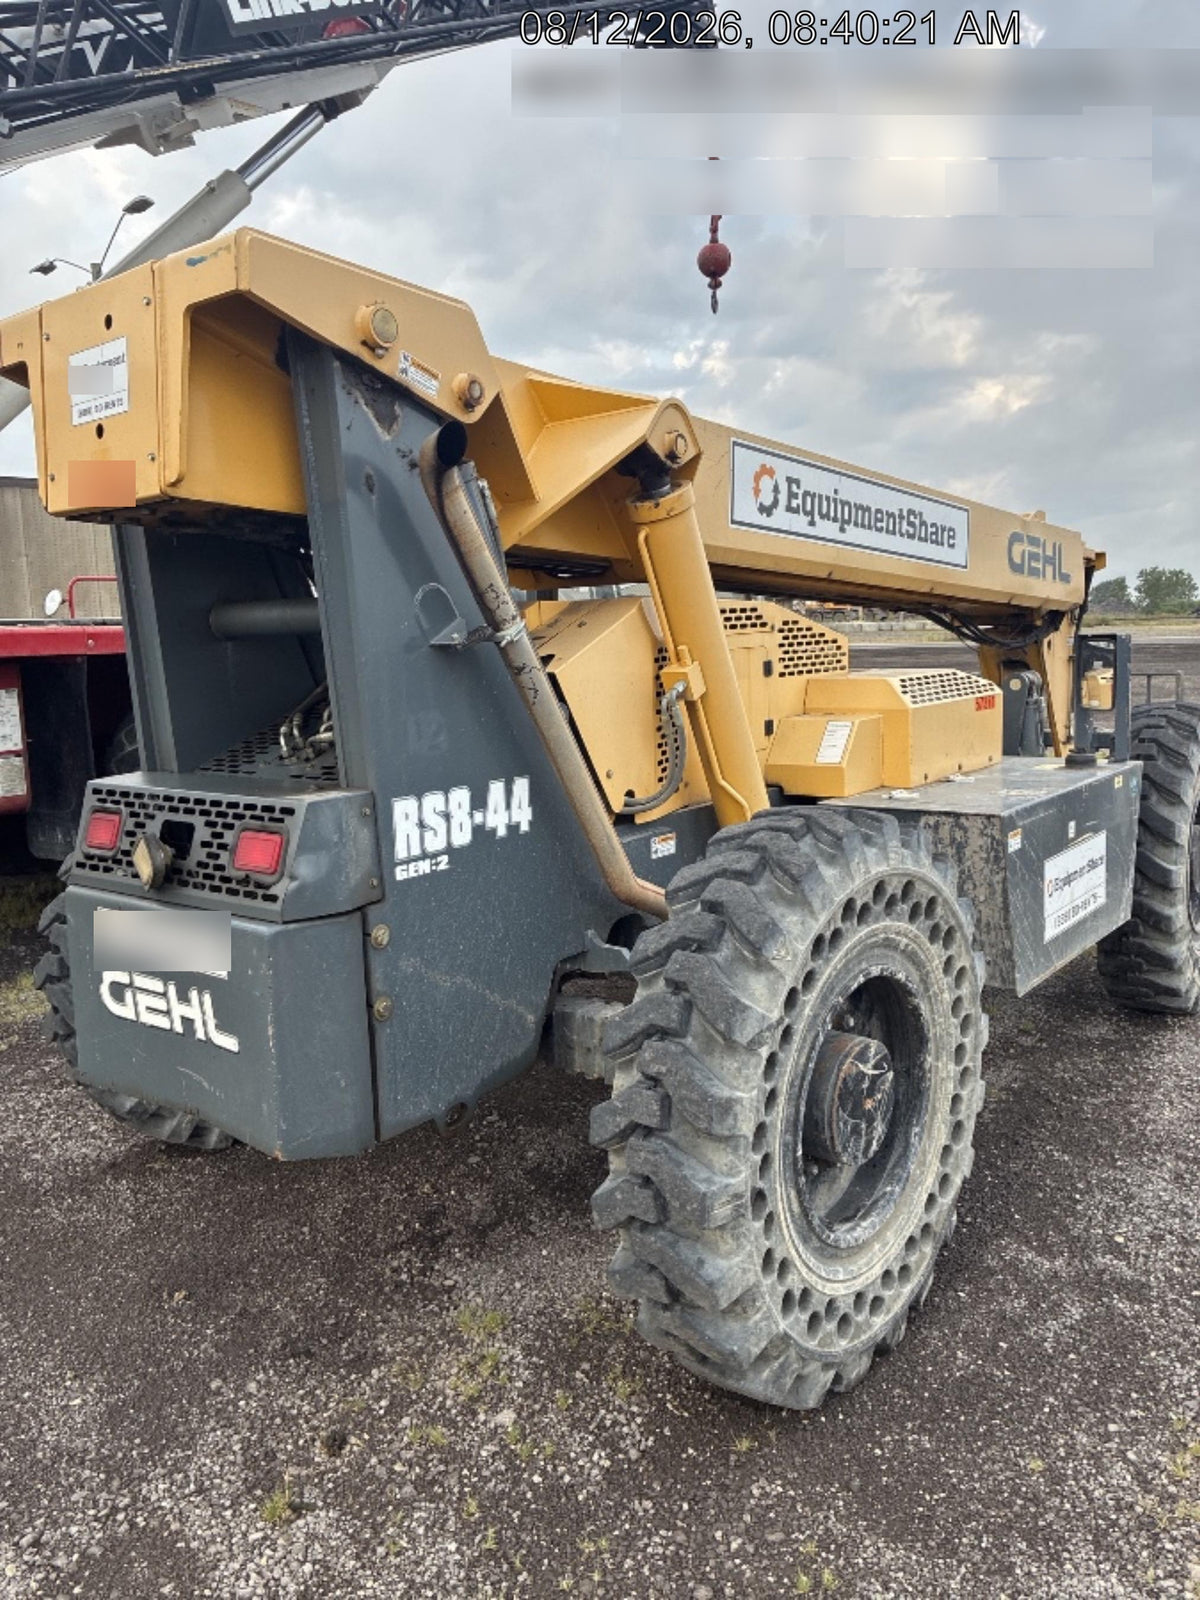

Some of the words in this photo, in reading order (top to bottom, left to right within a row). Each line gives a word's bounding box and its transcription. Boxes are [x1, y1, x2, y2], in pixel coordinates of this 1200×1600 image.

[785, 475, 957, 550] EquipmentShare
[1007, 530, 1072, 585] GEHL
[391, 774, 533, 863] RS8-44
[394, 854, 450, 881] GEN:2
[99, 970, 240, 1054] GEHL
